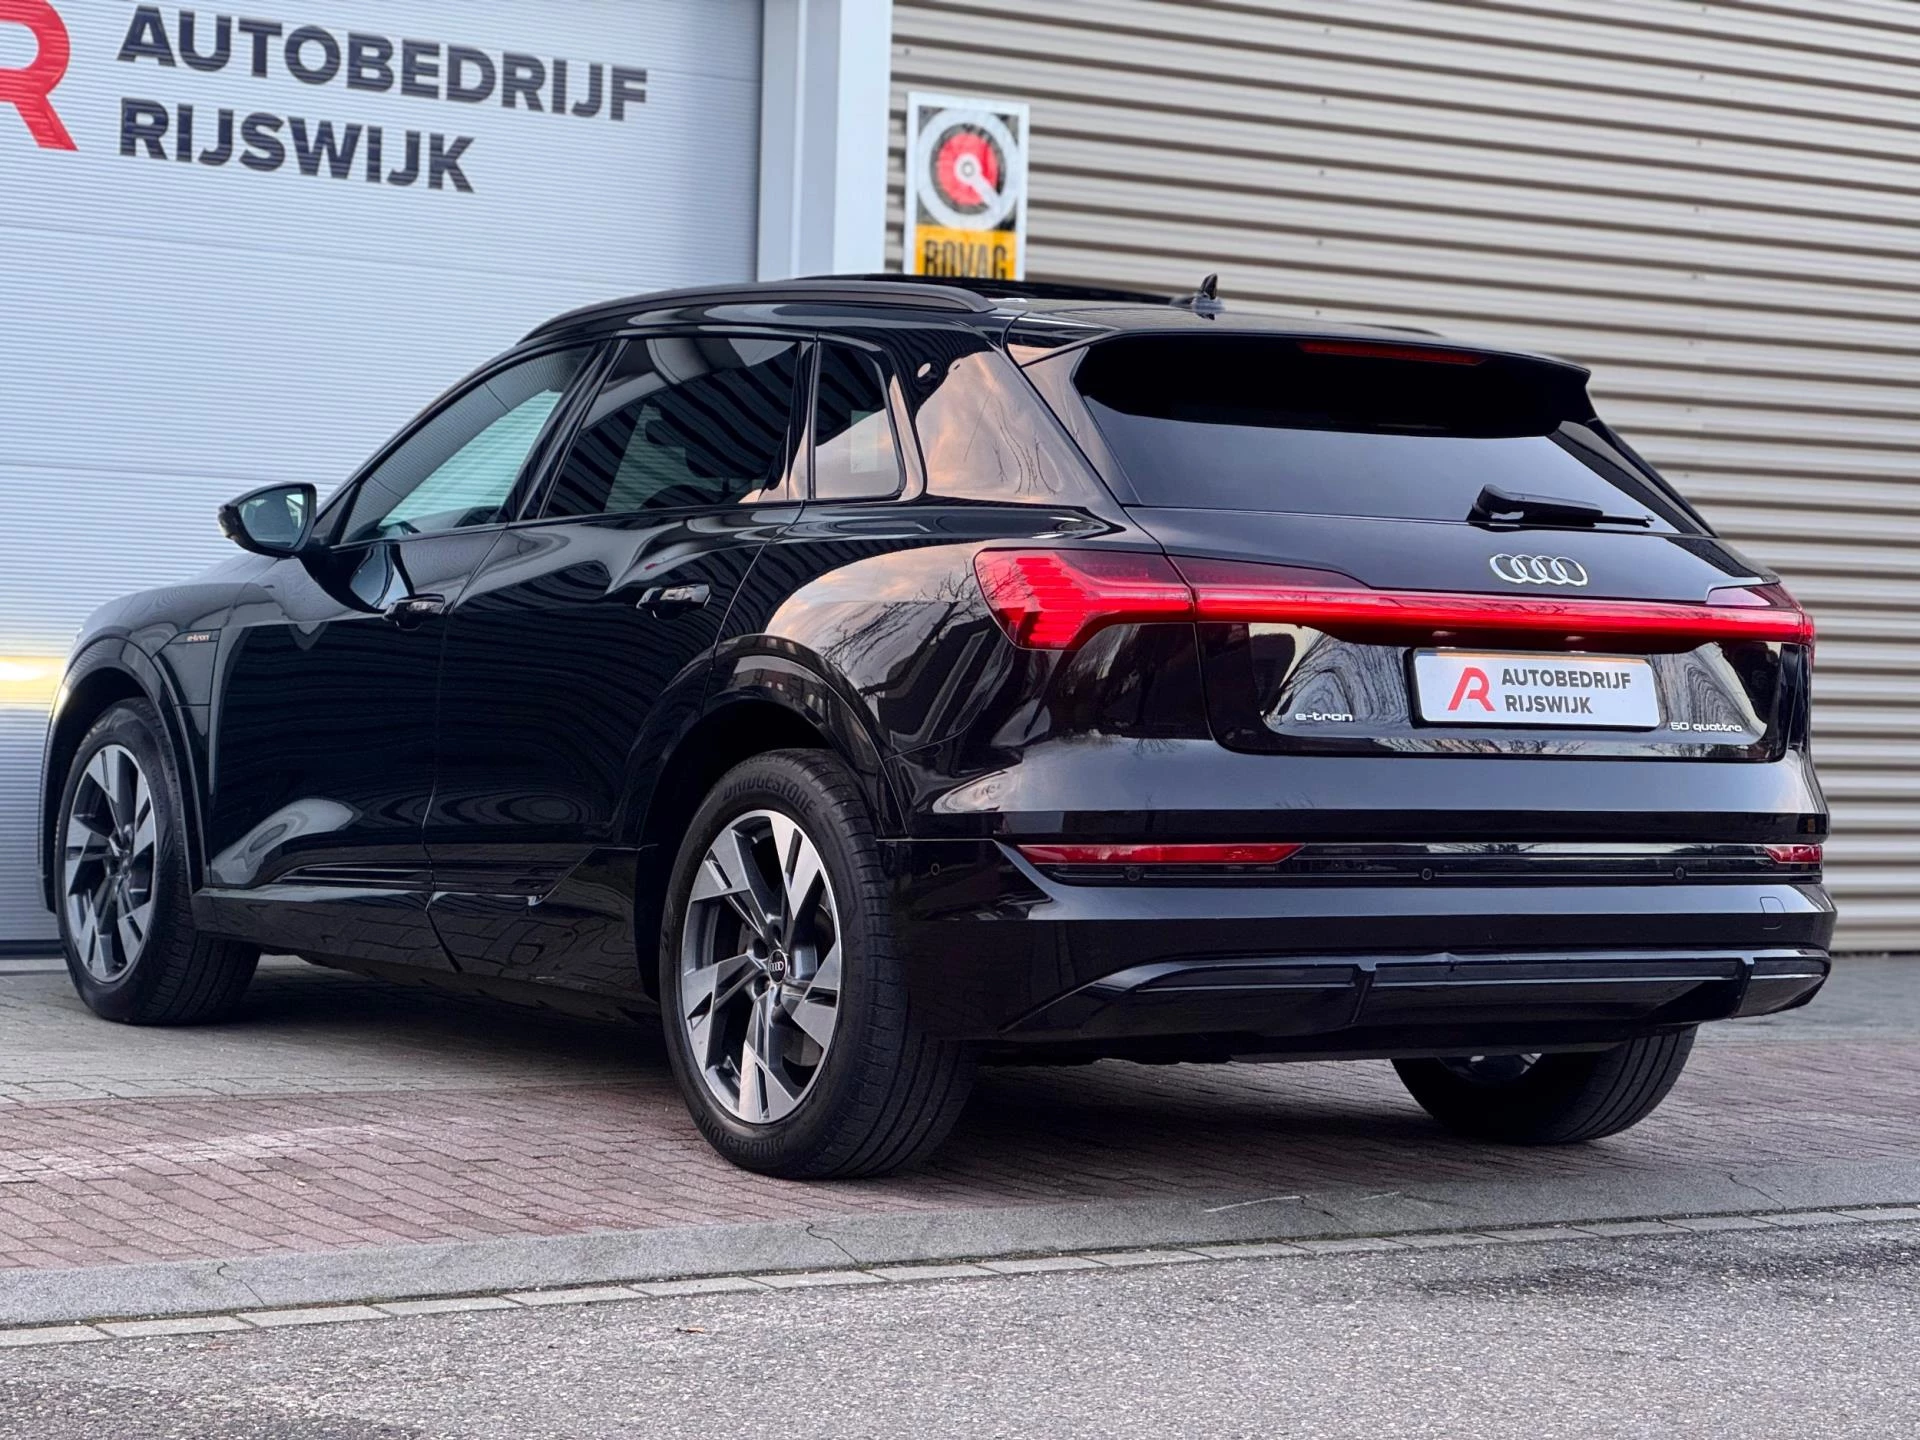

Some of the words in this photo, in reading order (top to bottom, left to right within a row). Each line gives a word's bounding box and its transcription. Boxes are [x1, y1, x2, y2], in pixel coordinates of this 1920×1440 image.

[117, 5, 648, 121] AUTOBEDRIJF
[119, 97, 475, 193] RIJSWIJK
[1501, 668, 1631, 689] AUTOBEDRIJF
[1504, 694, 1593, 714] RIJSWIJK
[1295, 711, 1353, 722] e-tron
[1671, 722, 1690, 730] 50
[1693, 722, 1743, 732] quattro
[722, 773, 818, 816] BRIDGESTONE
